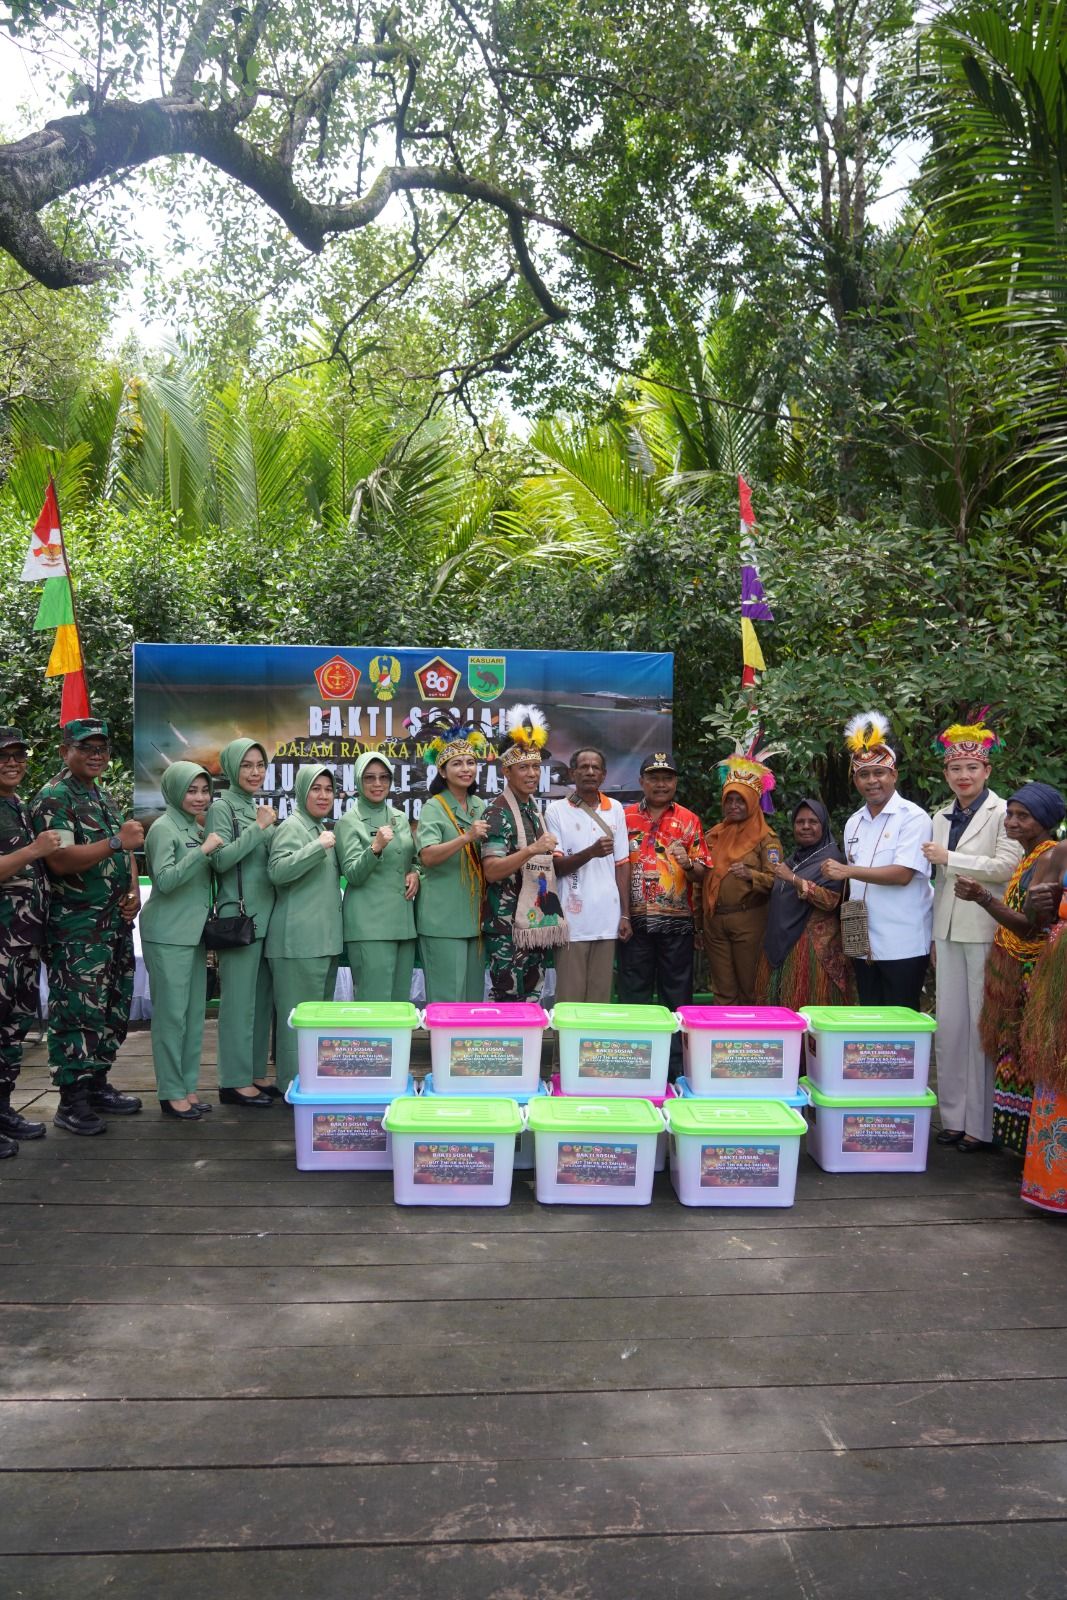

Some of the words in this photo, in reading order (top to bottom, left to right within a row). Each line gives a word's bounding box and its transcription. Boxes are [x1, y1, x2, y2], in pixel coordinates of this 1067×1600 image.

[309, 706, 393, 737] BAKTI
[276, 741, 337, 757] DALAM
[340, 742, 407, 758] RANGKA
